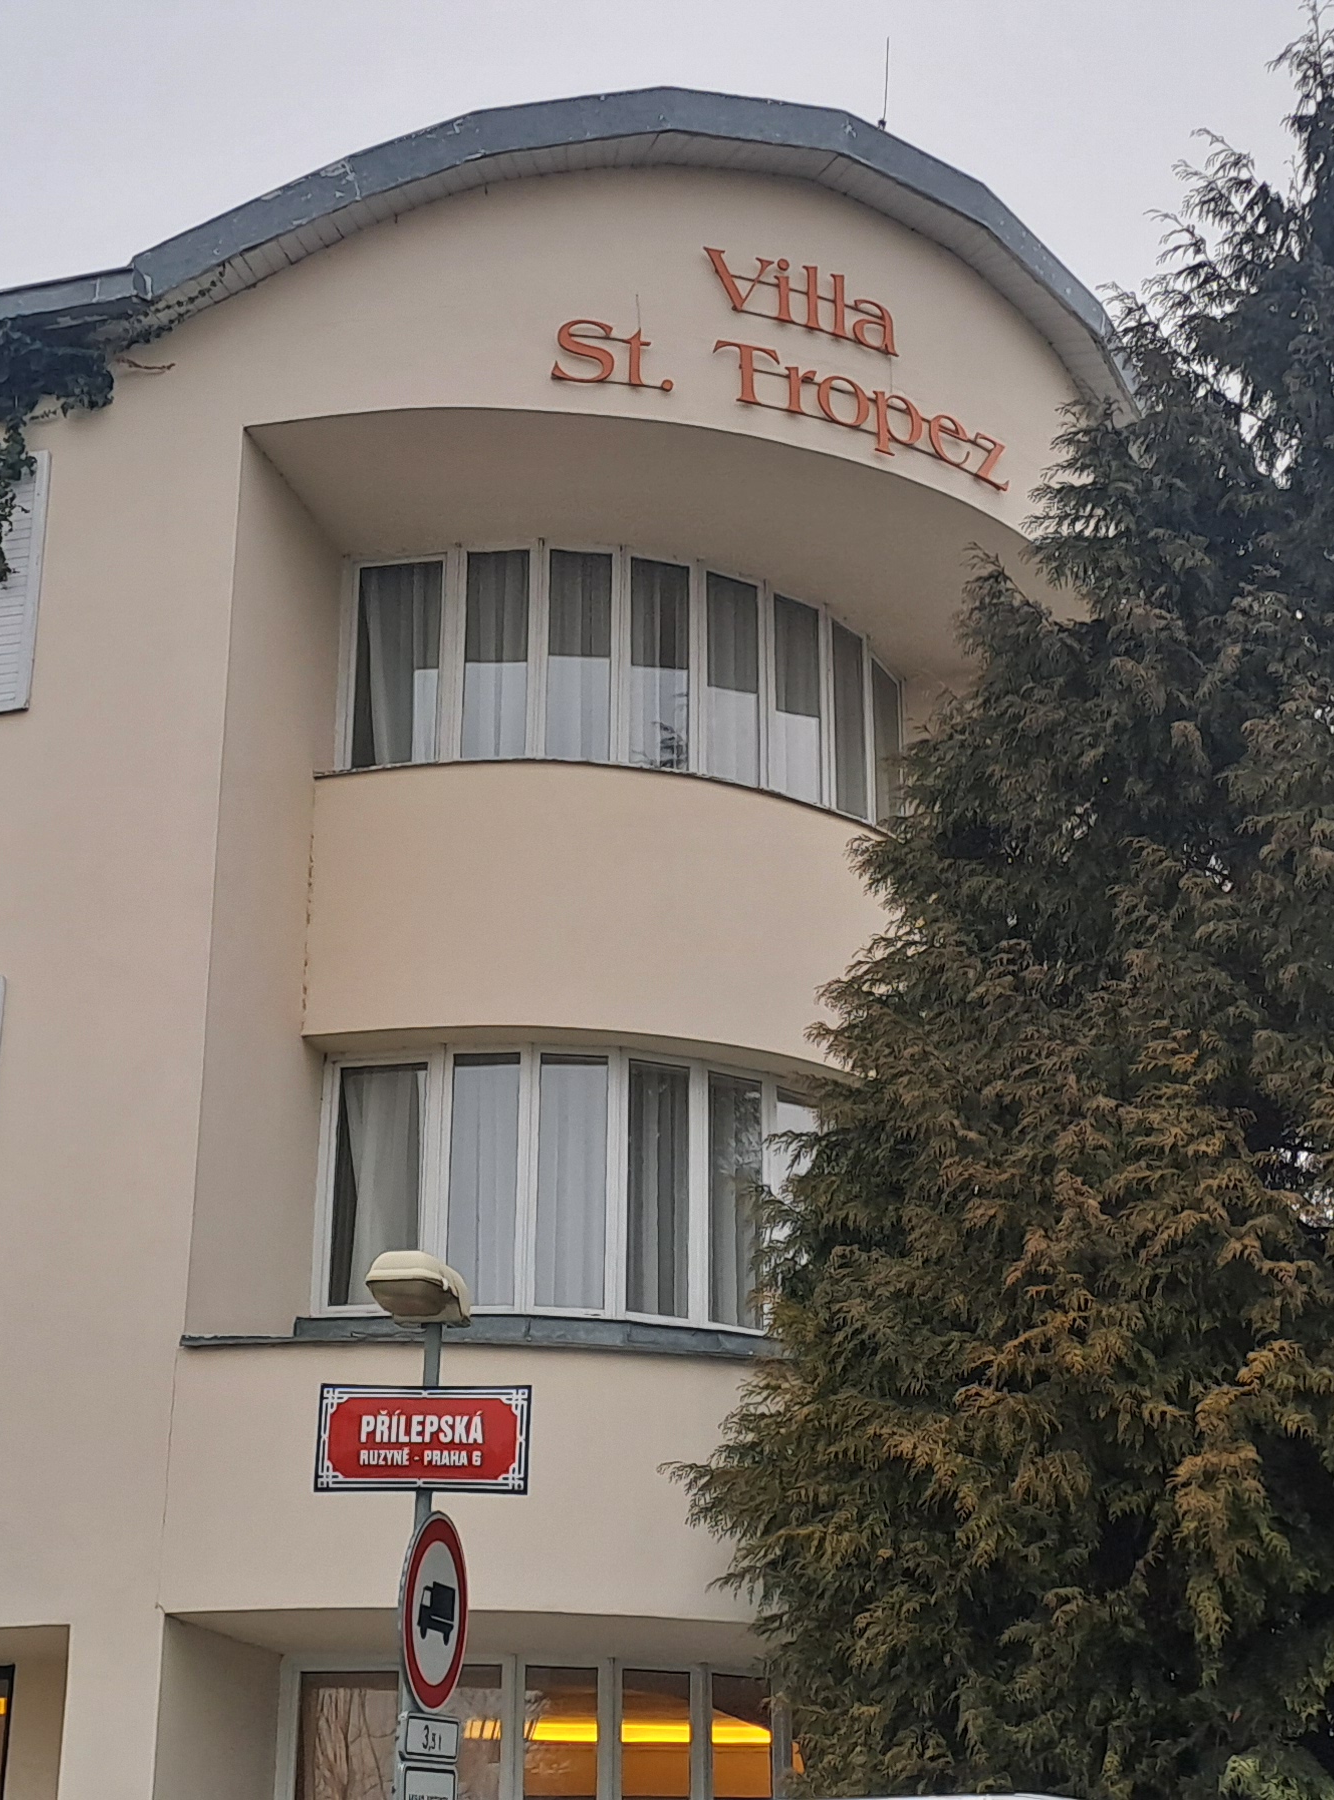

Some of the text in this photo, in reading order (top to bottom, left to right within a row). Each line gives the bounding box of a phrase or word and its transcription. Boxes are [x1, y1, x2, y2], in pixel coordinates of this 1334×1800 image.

[703, 247, 900, 357] Villa
[551, 319, 1010, 492] St. Tropez
[359, 1409, 484, 1444] PŘÍLEPSKÁ
[359, 1446, 411, 1466] RUZYNĚ
[423, 1449, 469, 1466] PRAHA
[471, 1450, 482, 1466] 6
